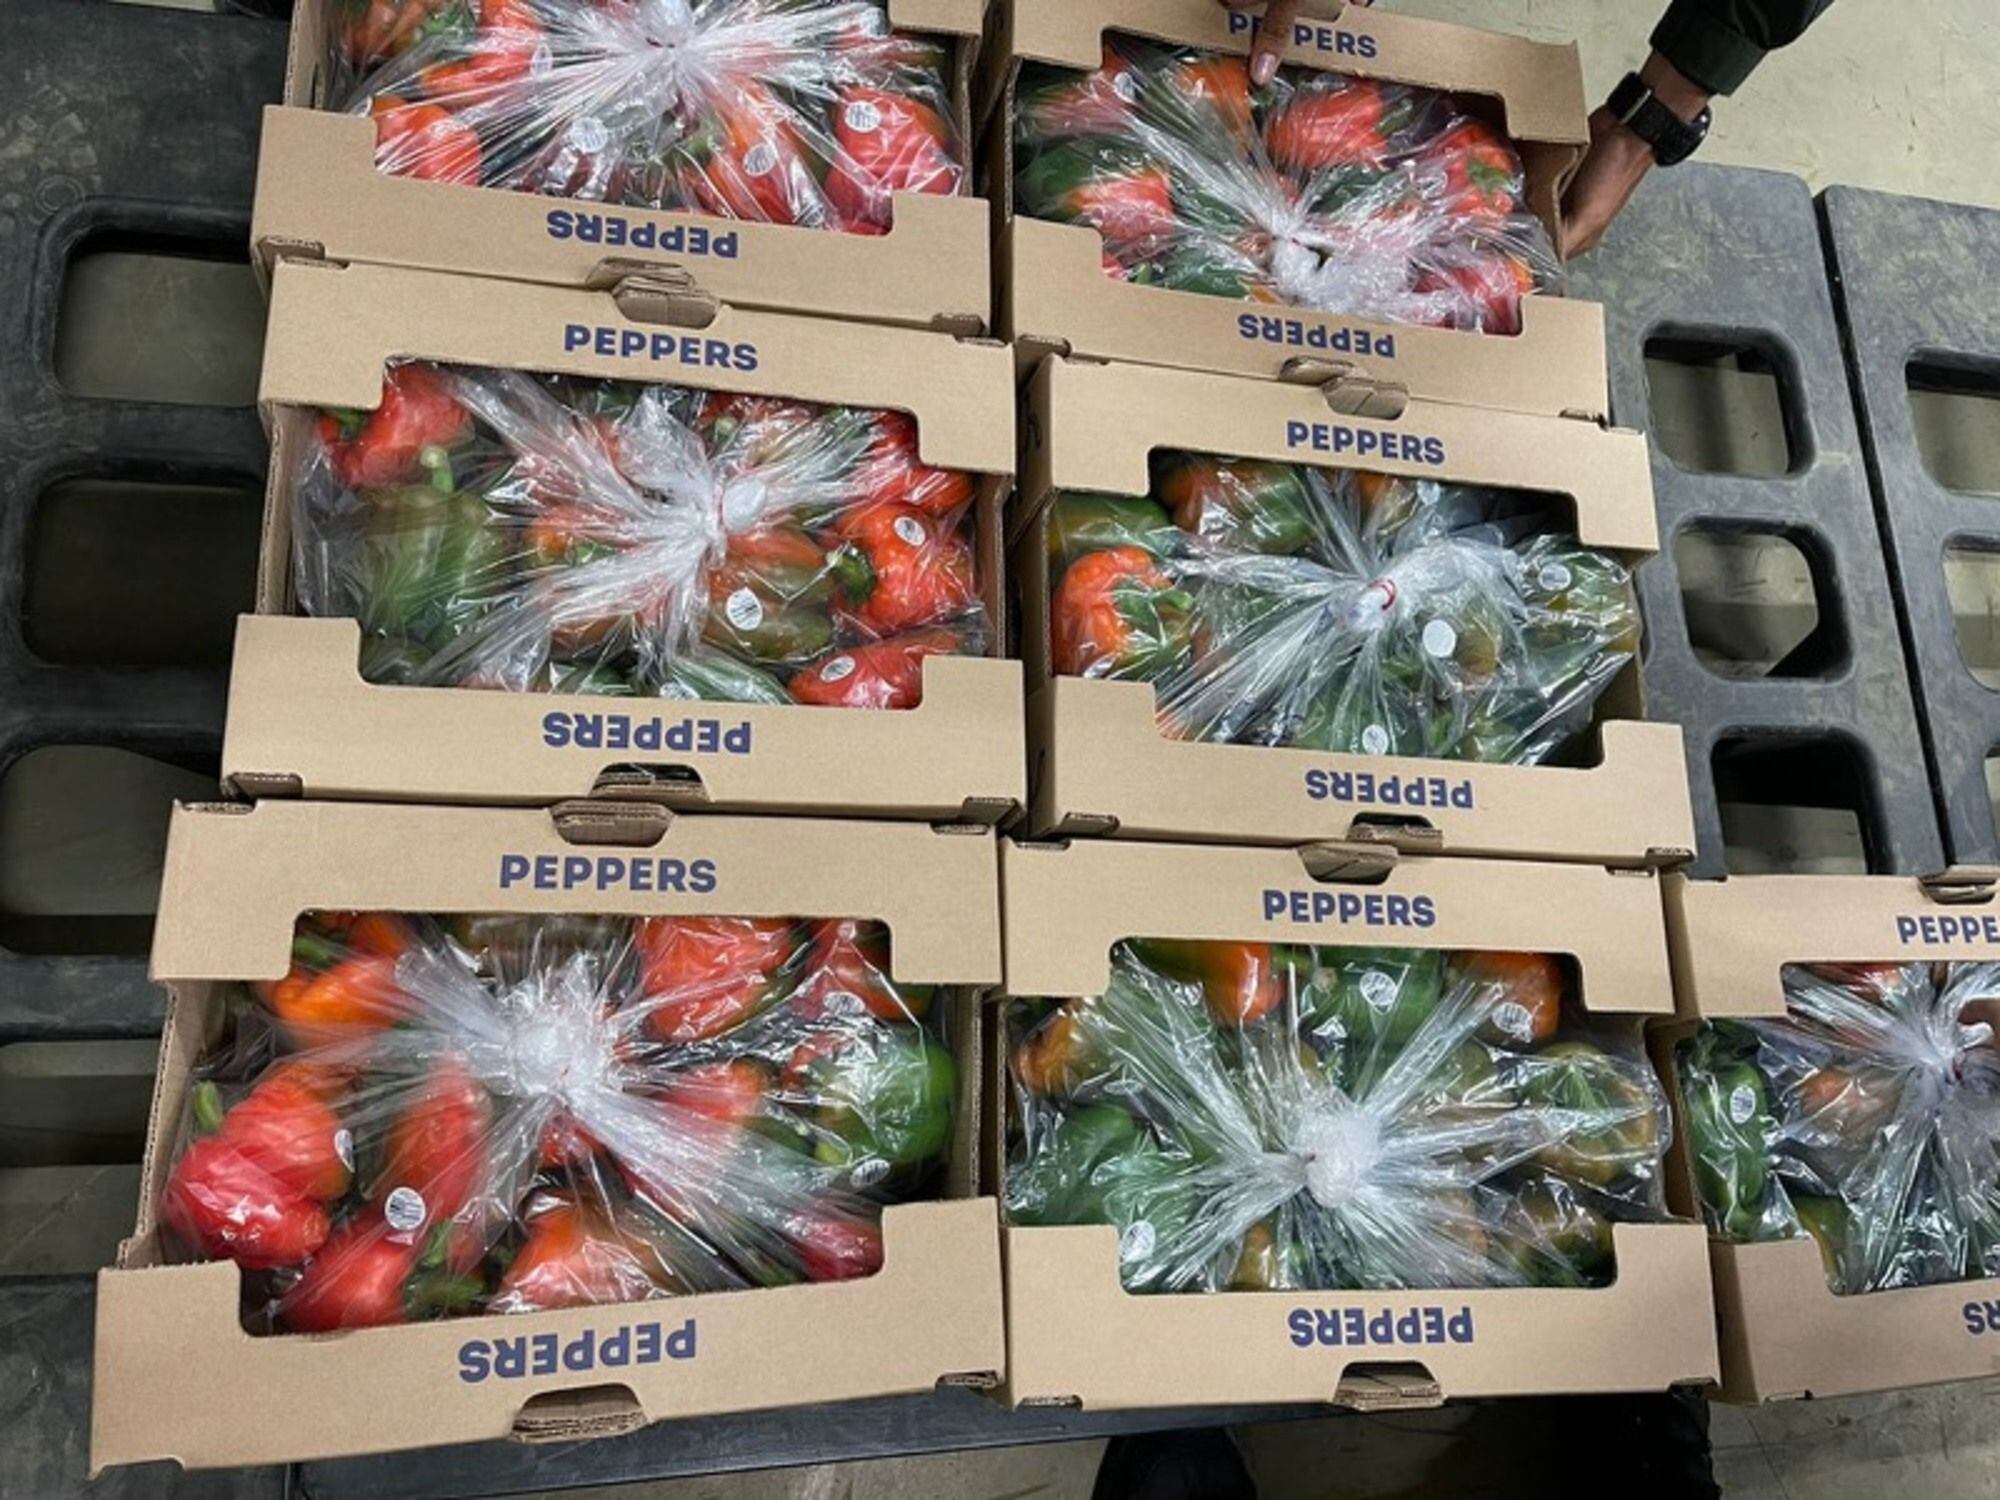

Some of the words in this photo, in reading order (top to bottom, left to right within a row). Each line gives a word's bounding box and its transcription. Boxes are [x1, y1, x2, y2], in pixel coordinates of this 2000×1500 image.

[1229, 11, 1377, 58] PPERS
[547, 210, 739, 258] PEPPERS
[564, 325, 758, 370] PEPPERS
[1238, 314, 1395, 357] PEPPERS
[1287, 422, 1445, 464] PEPPERS
[543, 712, 751, 753] PEPPERS
[1305, 770, 1473, 808] PEPPERS
[500, 855, 716, 892] PEPPERS
[1263, 890, 1436, 926] PEPPERS
[1896, 915, 2000, 943] PEPPE
[1288, 1307, 1473, 1347] PEPPERS
[458, 1319, 696, 1382] PEPPERS
